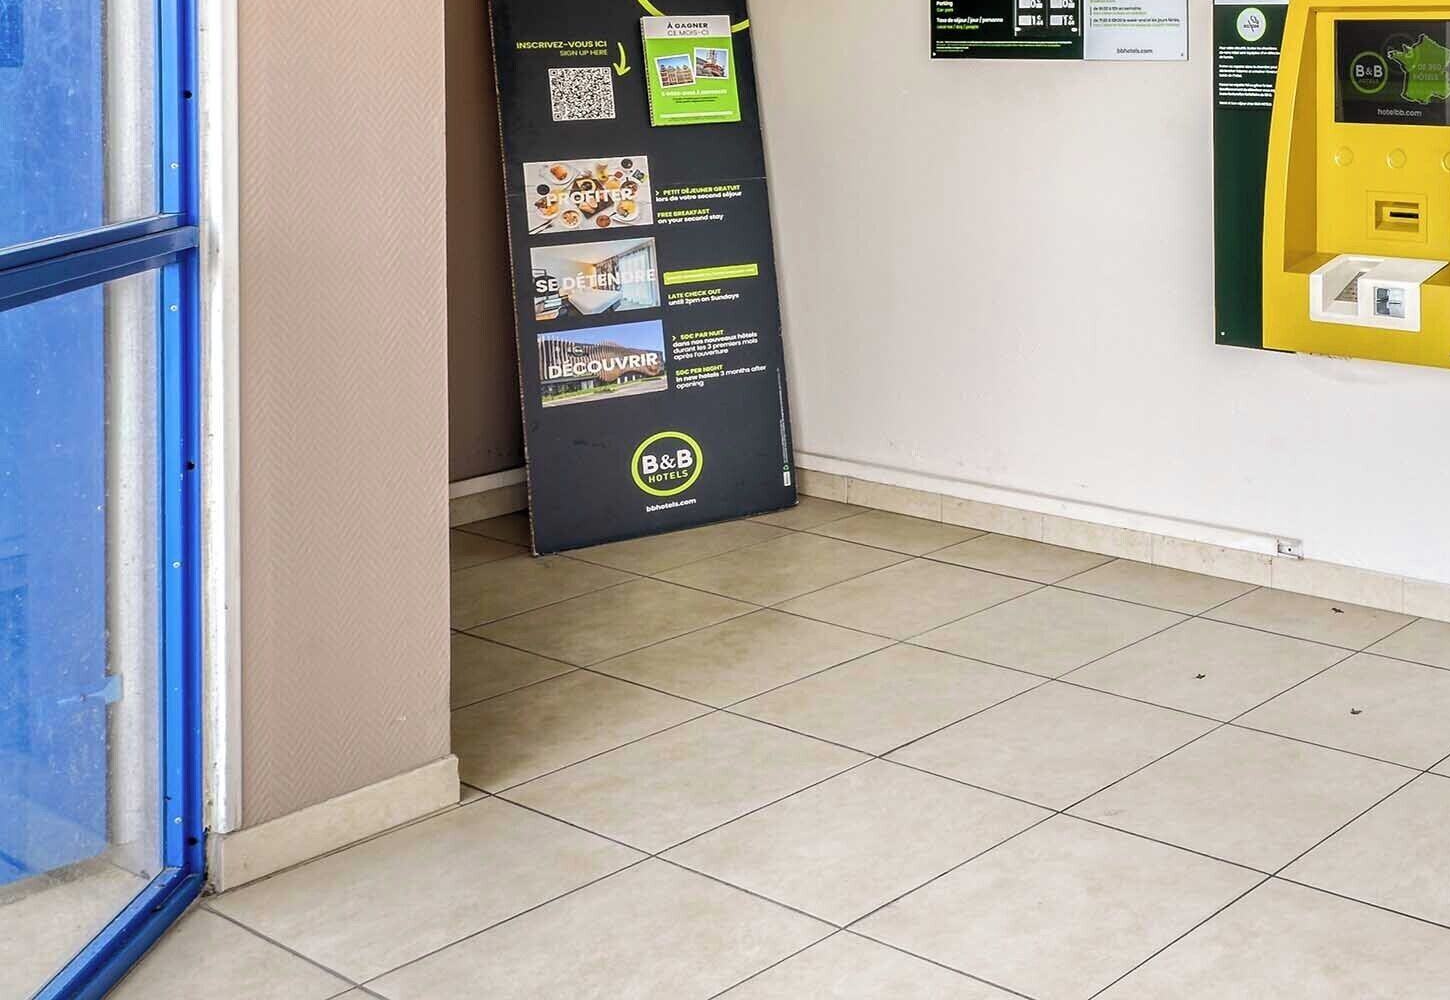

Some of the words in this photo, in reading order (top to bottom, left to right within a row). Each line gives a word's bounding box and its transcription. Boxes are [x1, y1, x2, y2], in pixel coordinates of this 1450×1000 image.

[516, 40, 594, 50] INSCRIVEZ-VOUS
[594, 40, 608, 48] ICI
[1355, 64, 1383, 78] B&B
[713, 184, 741, 192] GRATUIT
[545, 188, 633, 208] PROFITER
[667, 217, 683, 225] your
[684, 214, 709, 222] second
[709, 213, 724, 221] stay
[673, 208, 710, 217] BREAKFAST
[536, 277, 559, 294] SE
[562, 268, 657, 291] DÉTENDRE
[684, 290, 707, 298] CHECK
[685, 298, 701, 306] 2pm
[710, 292, 740, 302] Sundays
[672, 340, 690, 348] dans
[704, 335, 737, 344] nouveaux
[737, 331, 758, 339] hôtels
[694, 331, 709, 339] PAR
[708, 329, 724, 337] NUIT
[672, 346, 696, 355] durant
[712, 340, 742, 350] premiers
[673, 352, 693, 361] après
[693, 348, 729, 358] l'ouverture
[548, 351, 659, 380] DÉCOUVRIR
[690, 367, 702, 375] PER
[702, 364, 723, 373] NIGHT
[683, 374, 698, 382] new
[698, 371, 719, 379] hotels
[725, 368, 750, 376] months
[750, 365, 767, 373] after
[675, 380, 705, 390] opening
[641, 448, 693, 475] B&B
[648, 469, 689, 483] HOTELS
[645, 498, 697, 513] bbhotels.com
